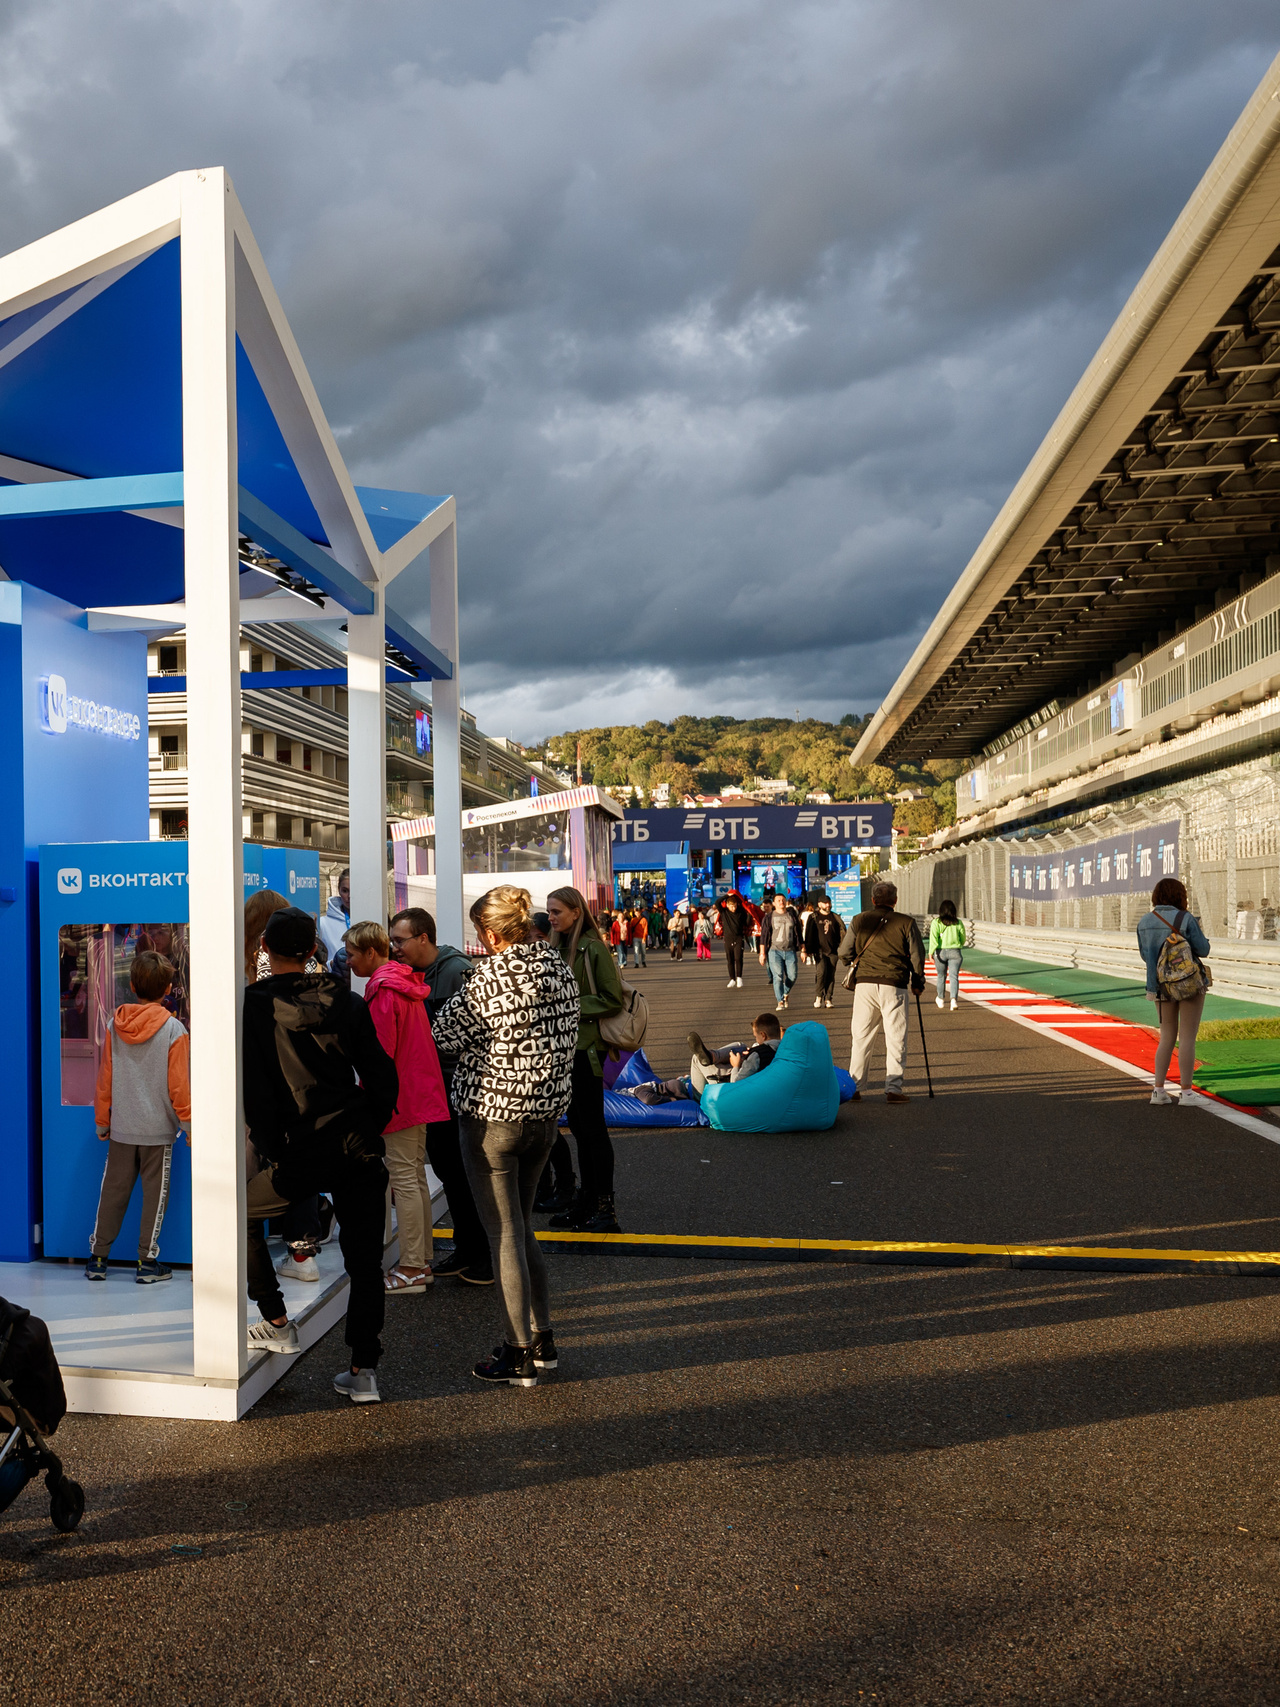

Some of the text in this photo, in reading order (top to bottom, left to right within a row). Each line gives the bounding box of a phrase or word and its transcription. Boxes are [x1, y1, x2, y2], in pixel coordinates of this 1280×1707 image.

[72, 695, 141, 740] вконтакте
[476, 810, 518, 821] Ростелеком
[708, 817, 761, 841] ВТБ
[821, 815, 875, 839] ВТБ
[1162, 843, 1175, 875] ВТБ
[89, 872, 189, 888] вконтакт
